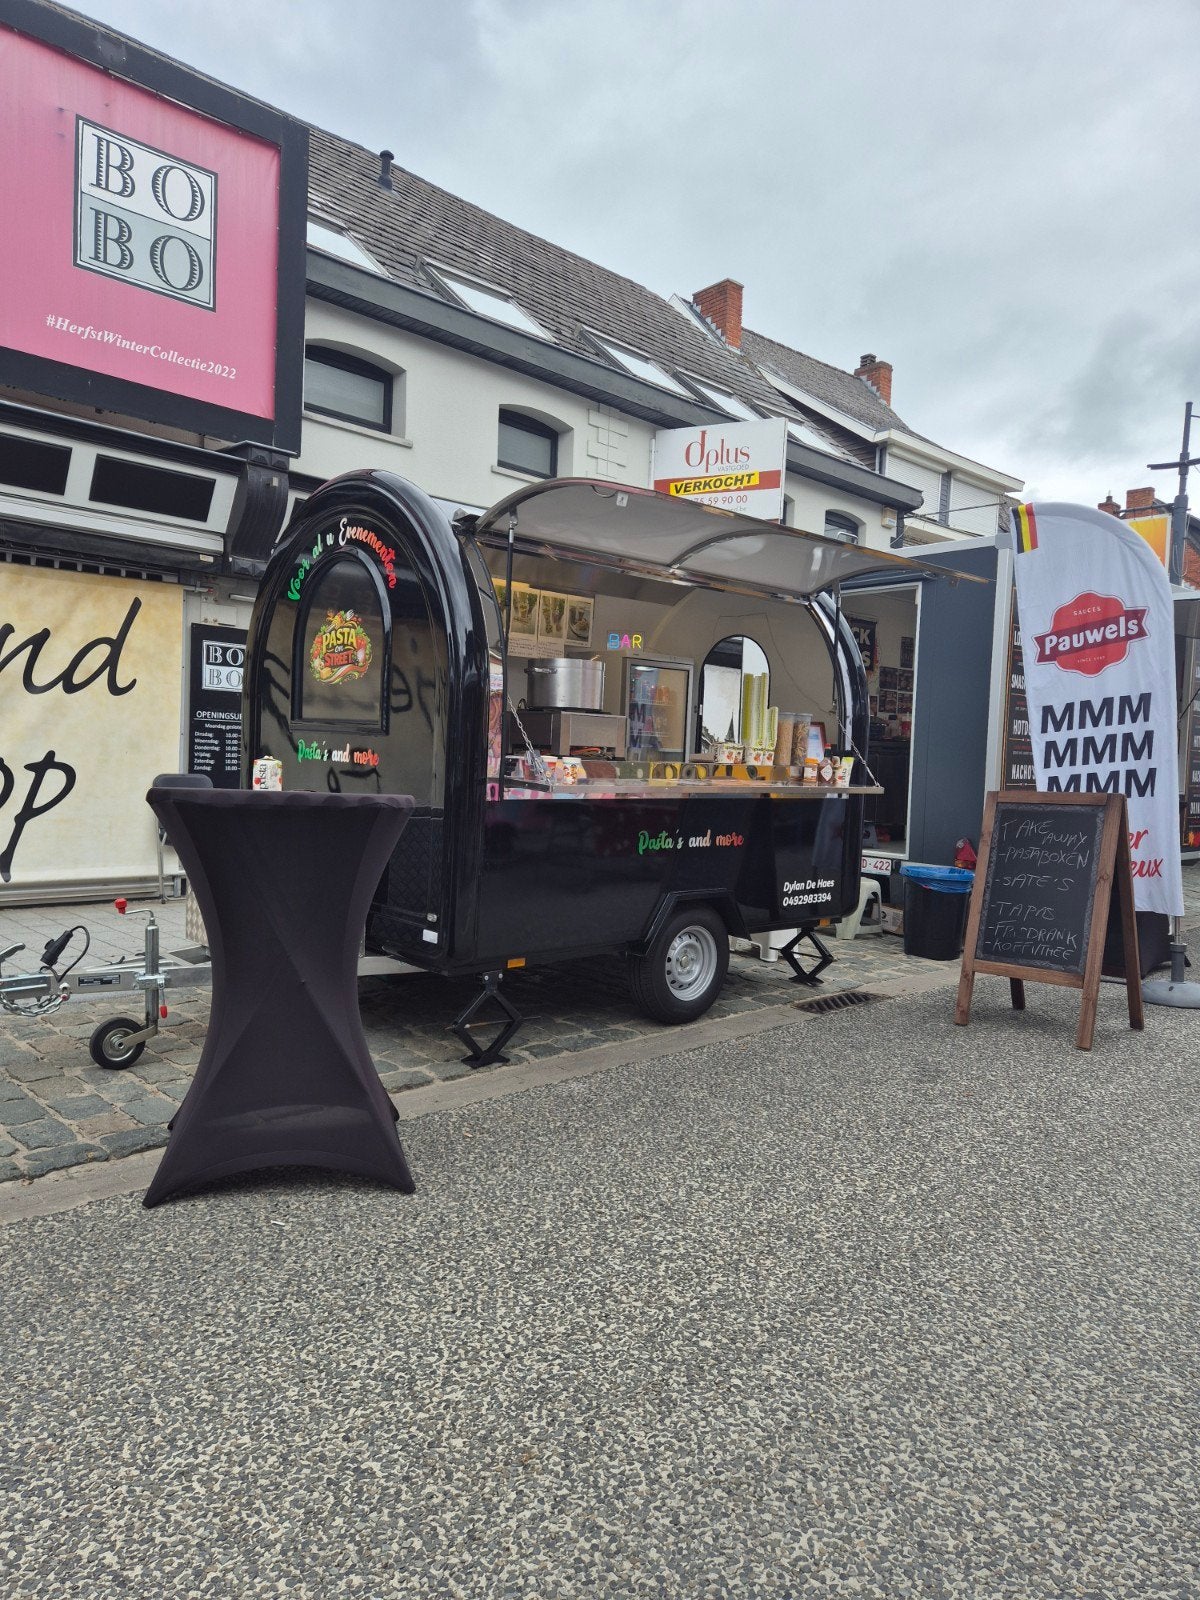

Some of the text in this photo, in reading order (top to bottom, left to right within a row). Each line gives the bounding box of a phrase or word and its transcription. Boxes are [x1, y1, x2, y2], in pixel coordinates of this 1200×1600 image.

[89, 133, 206, 222] BO
[88, 206, 204, 292] BO
[46, 313, 237, 379] #HerfstWinterCollectie2022
[674, 473, 755, 494] VERKOCHT
[735, 494, 748, 503] 00
[288, 558, 310, 600] Voor
[312, 533, 323, 559] al
[1073, 606, 1102, 616] SAUCES
[322, 627, 357, 655] PASTA
[608, 633, 642, 649] BAR
[1045, 616, 1139, 655] Pauwels
[208, 645, 244, 666] BO
[324, 650, 354, 667] STREET
[1041, 692, 1152, 734] MMM
[297, 738, 380, 767] Pasta's and more
[1044, 730, 1154, 769] MMM
[638, 829, 744, 855] Pasta's and more
[1002, 819, 1056, 841] TAKE
[1041, 832, 1088, 851] AWAY
[783, 878, 835, 894] Dylan De Haes
[782, 892, 832, 907] 0492983394
